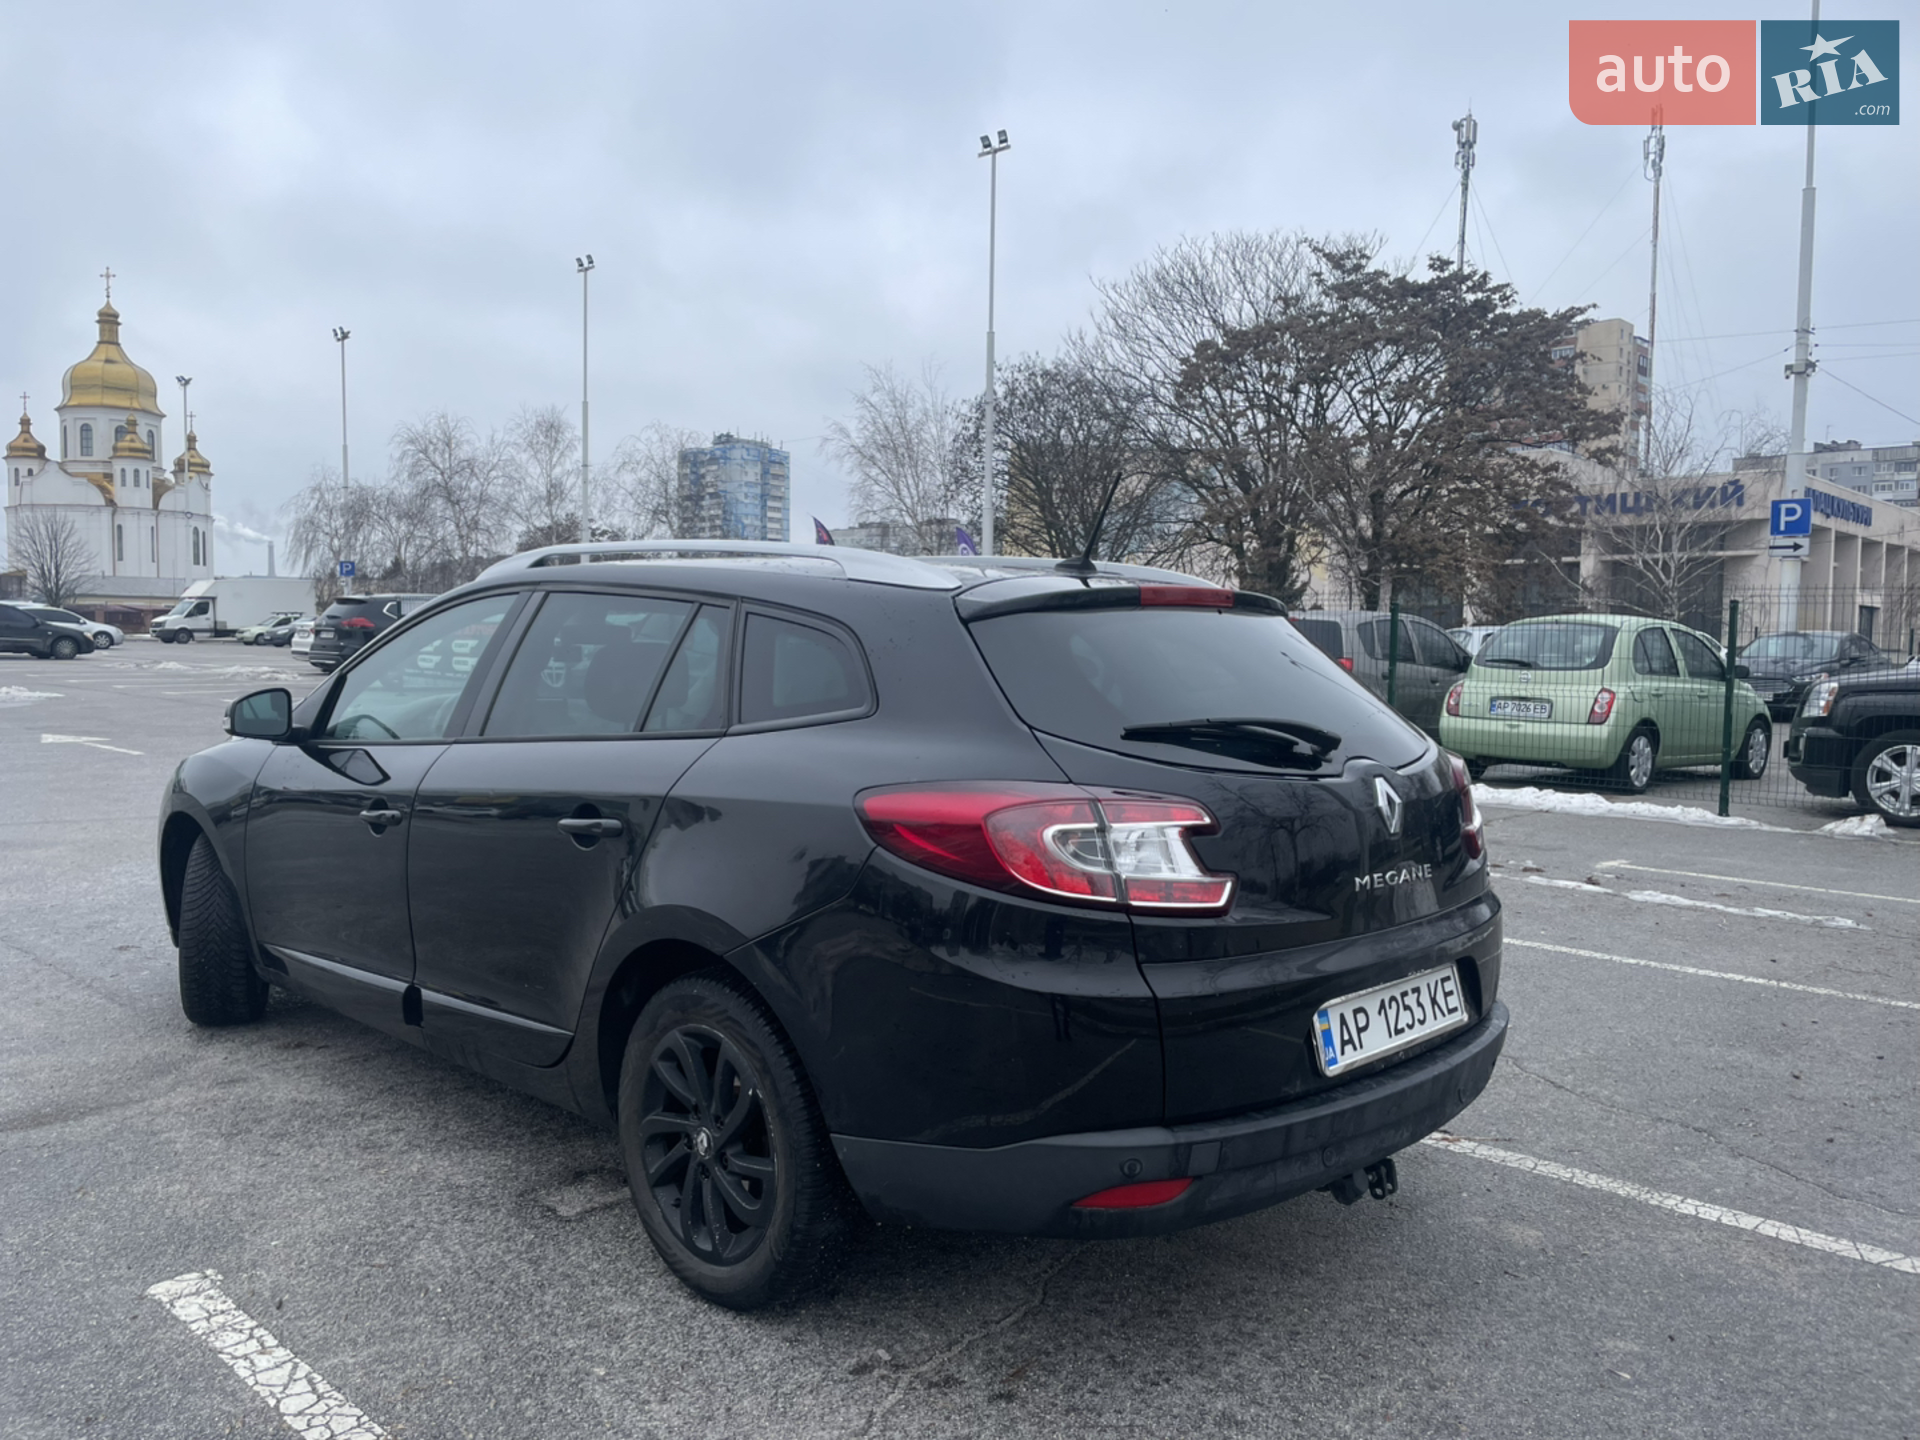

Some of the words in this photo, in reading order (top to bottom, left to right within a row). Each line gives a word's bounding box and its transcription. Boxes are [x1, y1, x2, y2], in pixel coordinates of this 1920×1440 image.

[1779, 503, 1802, 532] P
[342, 562, 352, 574] P
[1354, 863, 1433, 892] MEGANE
[1339, 1006, 1370, 1056] AP
[1377, 986, 1427, 1039] 1253
[1427, 975, 1459, 1021] KE
